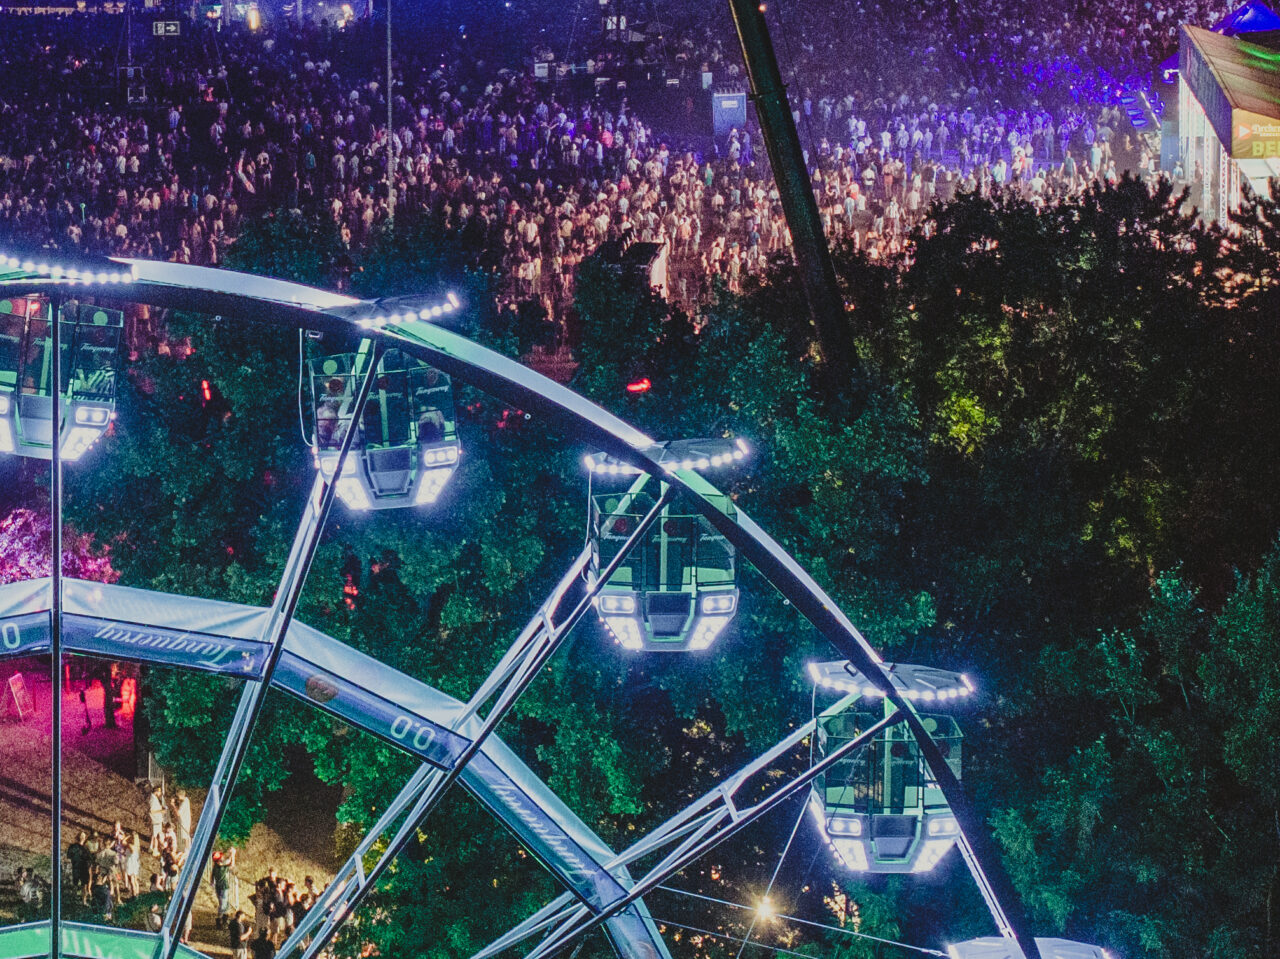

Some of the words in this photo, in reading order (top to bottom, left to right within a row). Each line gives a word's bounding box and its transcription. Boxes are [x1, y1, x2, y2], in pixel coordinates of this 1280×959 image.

[1252, 141, 1280, 156] BE
[93, 622, 235, 669] Tanqueray
[390, 715, 436, 751] 0.0
